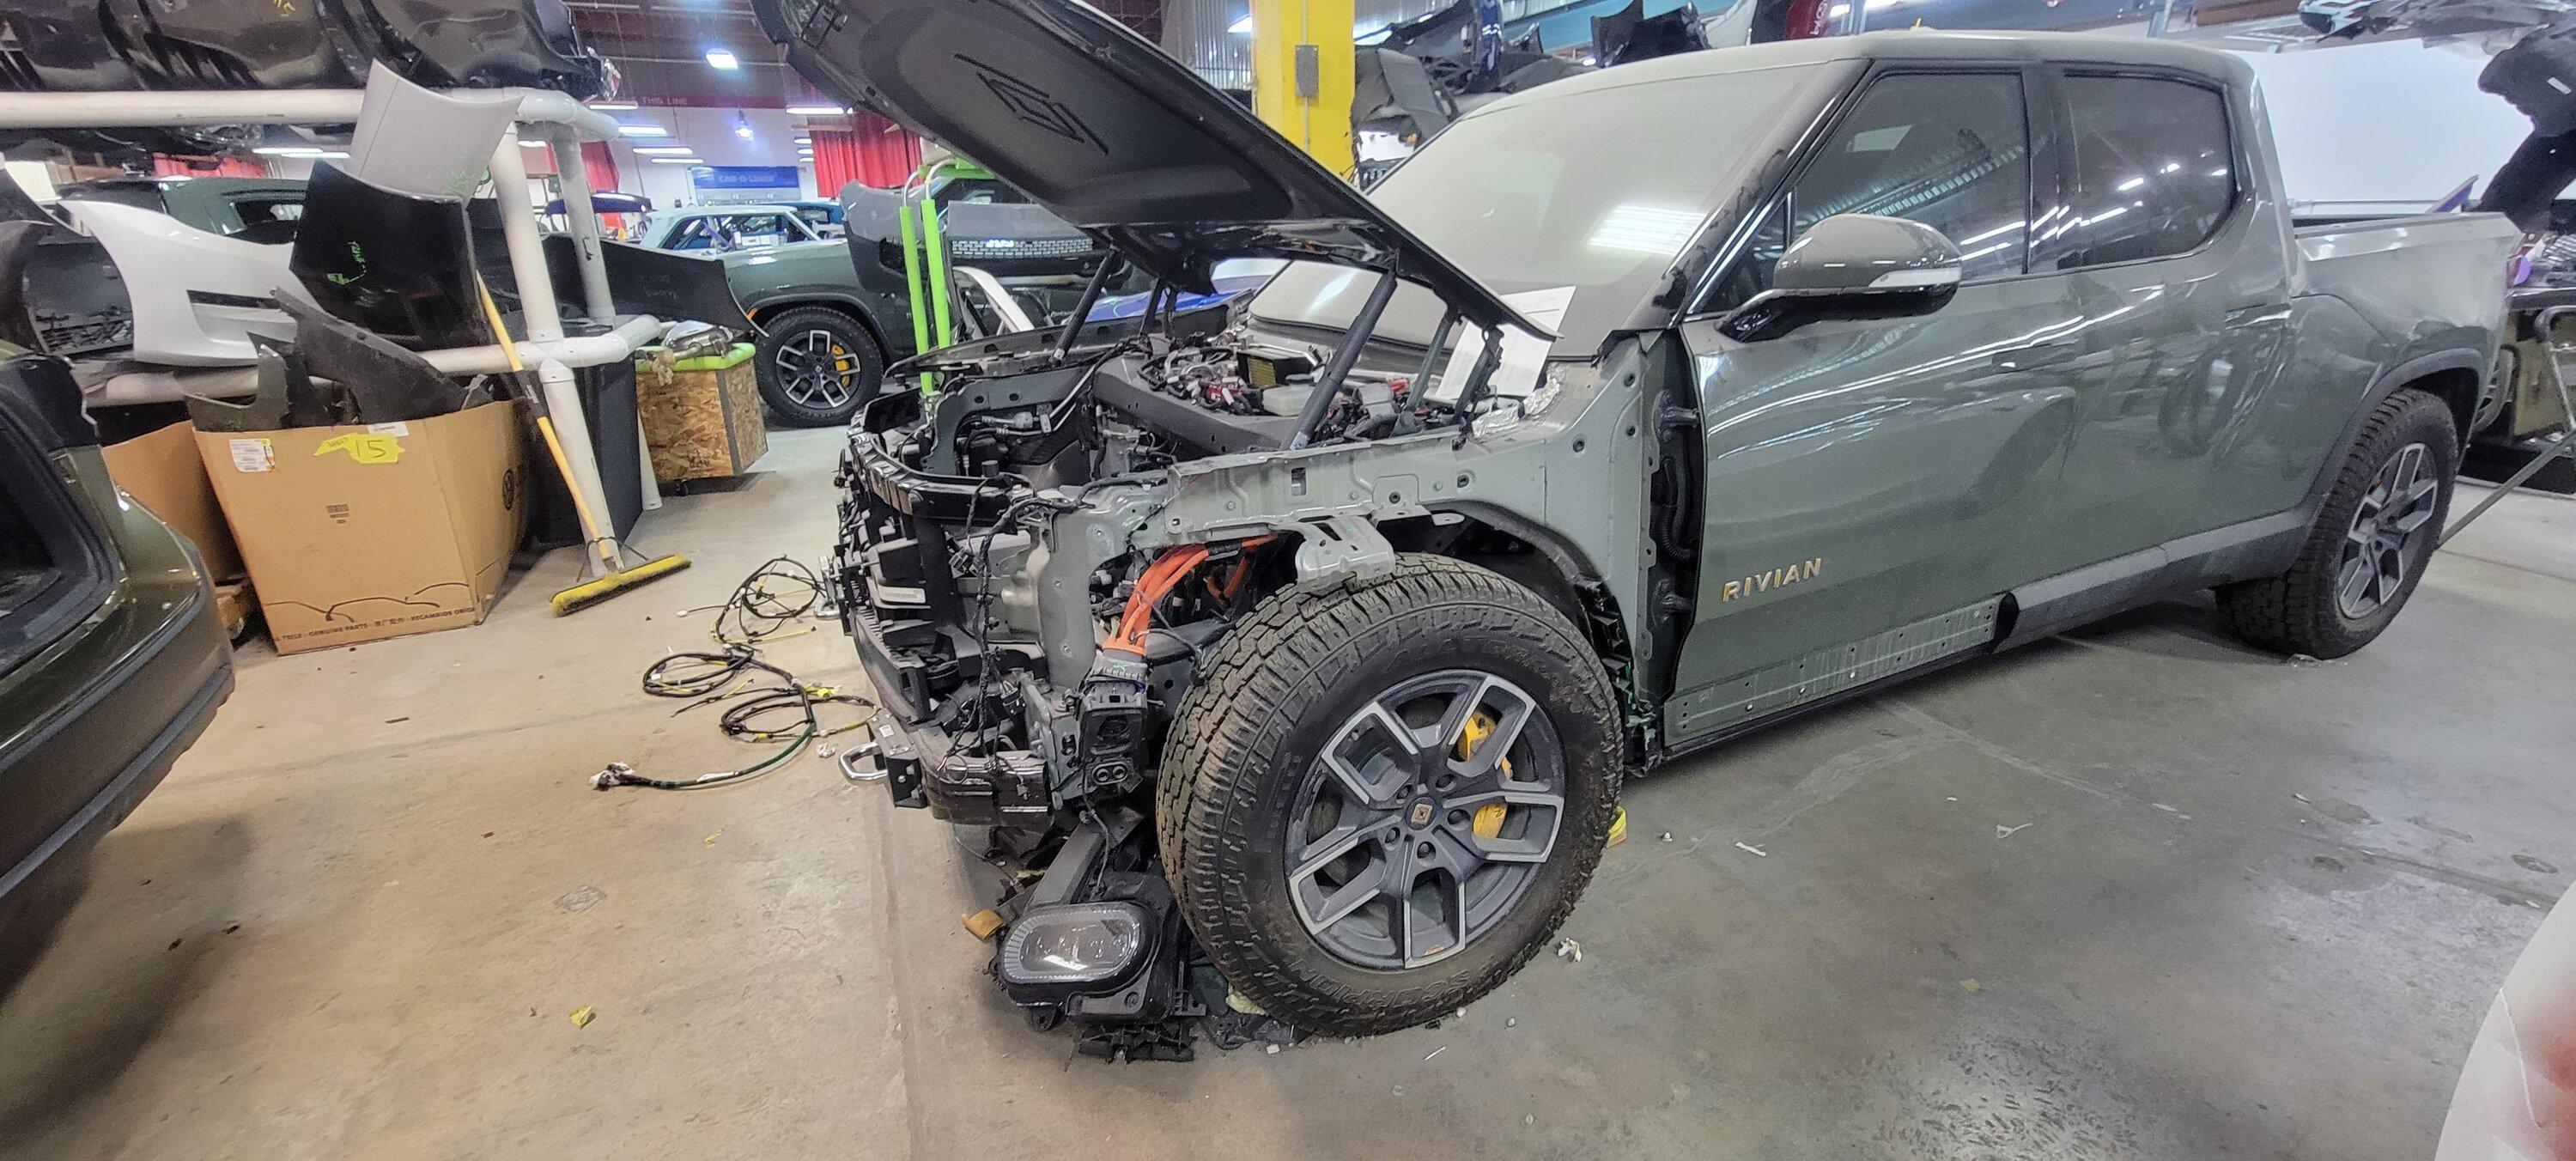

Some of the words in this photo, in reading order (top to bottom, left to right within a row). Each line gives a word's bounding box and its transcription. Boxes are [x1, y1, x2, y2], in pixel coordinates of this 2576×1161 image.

[355, 439, 386, 459] 15
[1722, 558, 1821, 602] RIVIAN
[345, 623, 368, 632] PARTS
[1287, 957, 1471, 1010] SCORPION
